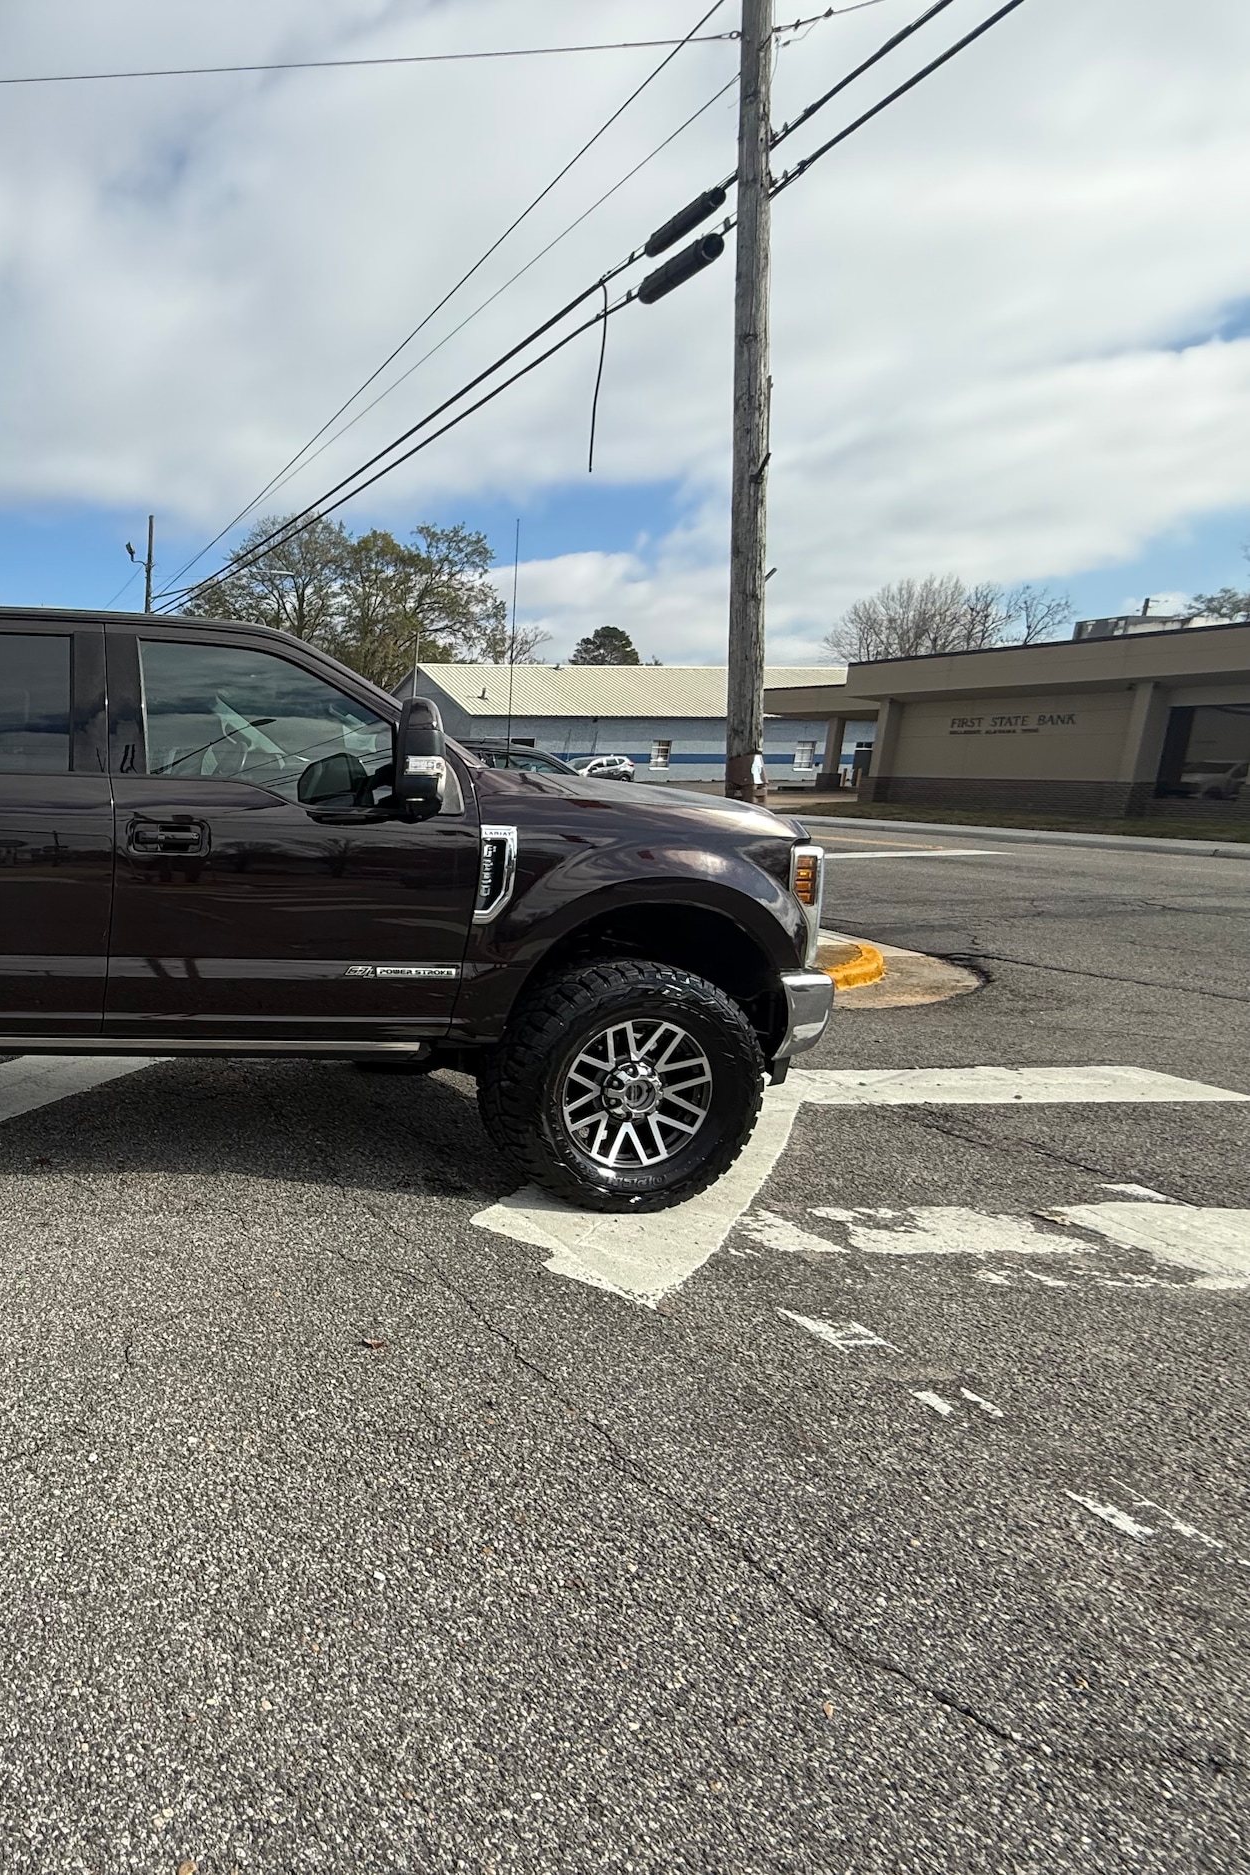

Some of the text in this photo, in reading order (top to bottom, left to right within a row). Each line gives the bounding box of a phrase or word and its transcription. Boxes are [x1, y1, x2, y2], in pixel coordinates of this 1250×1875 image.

[950, 713, 1077, 729] FIRST STATE BANK
[379, 968, 413, 976] POWER
